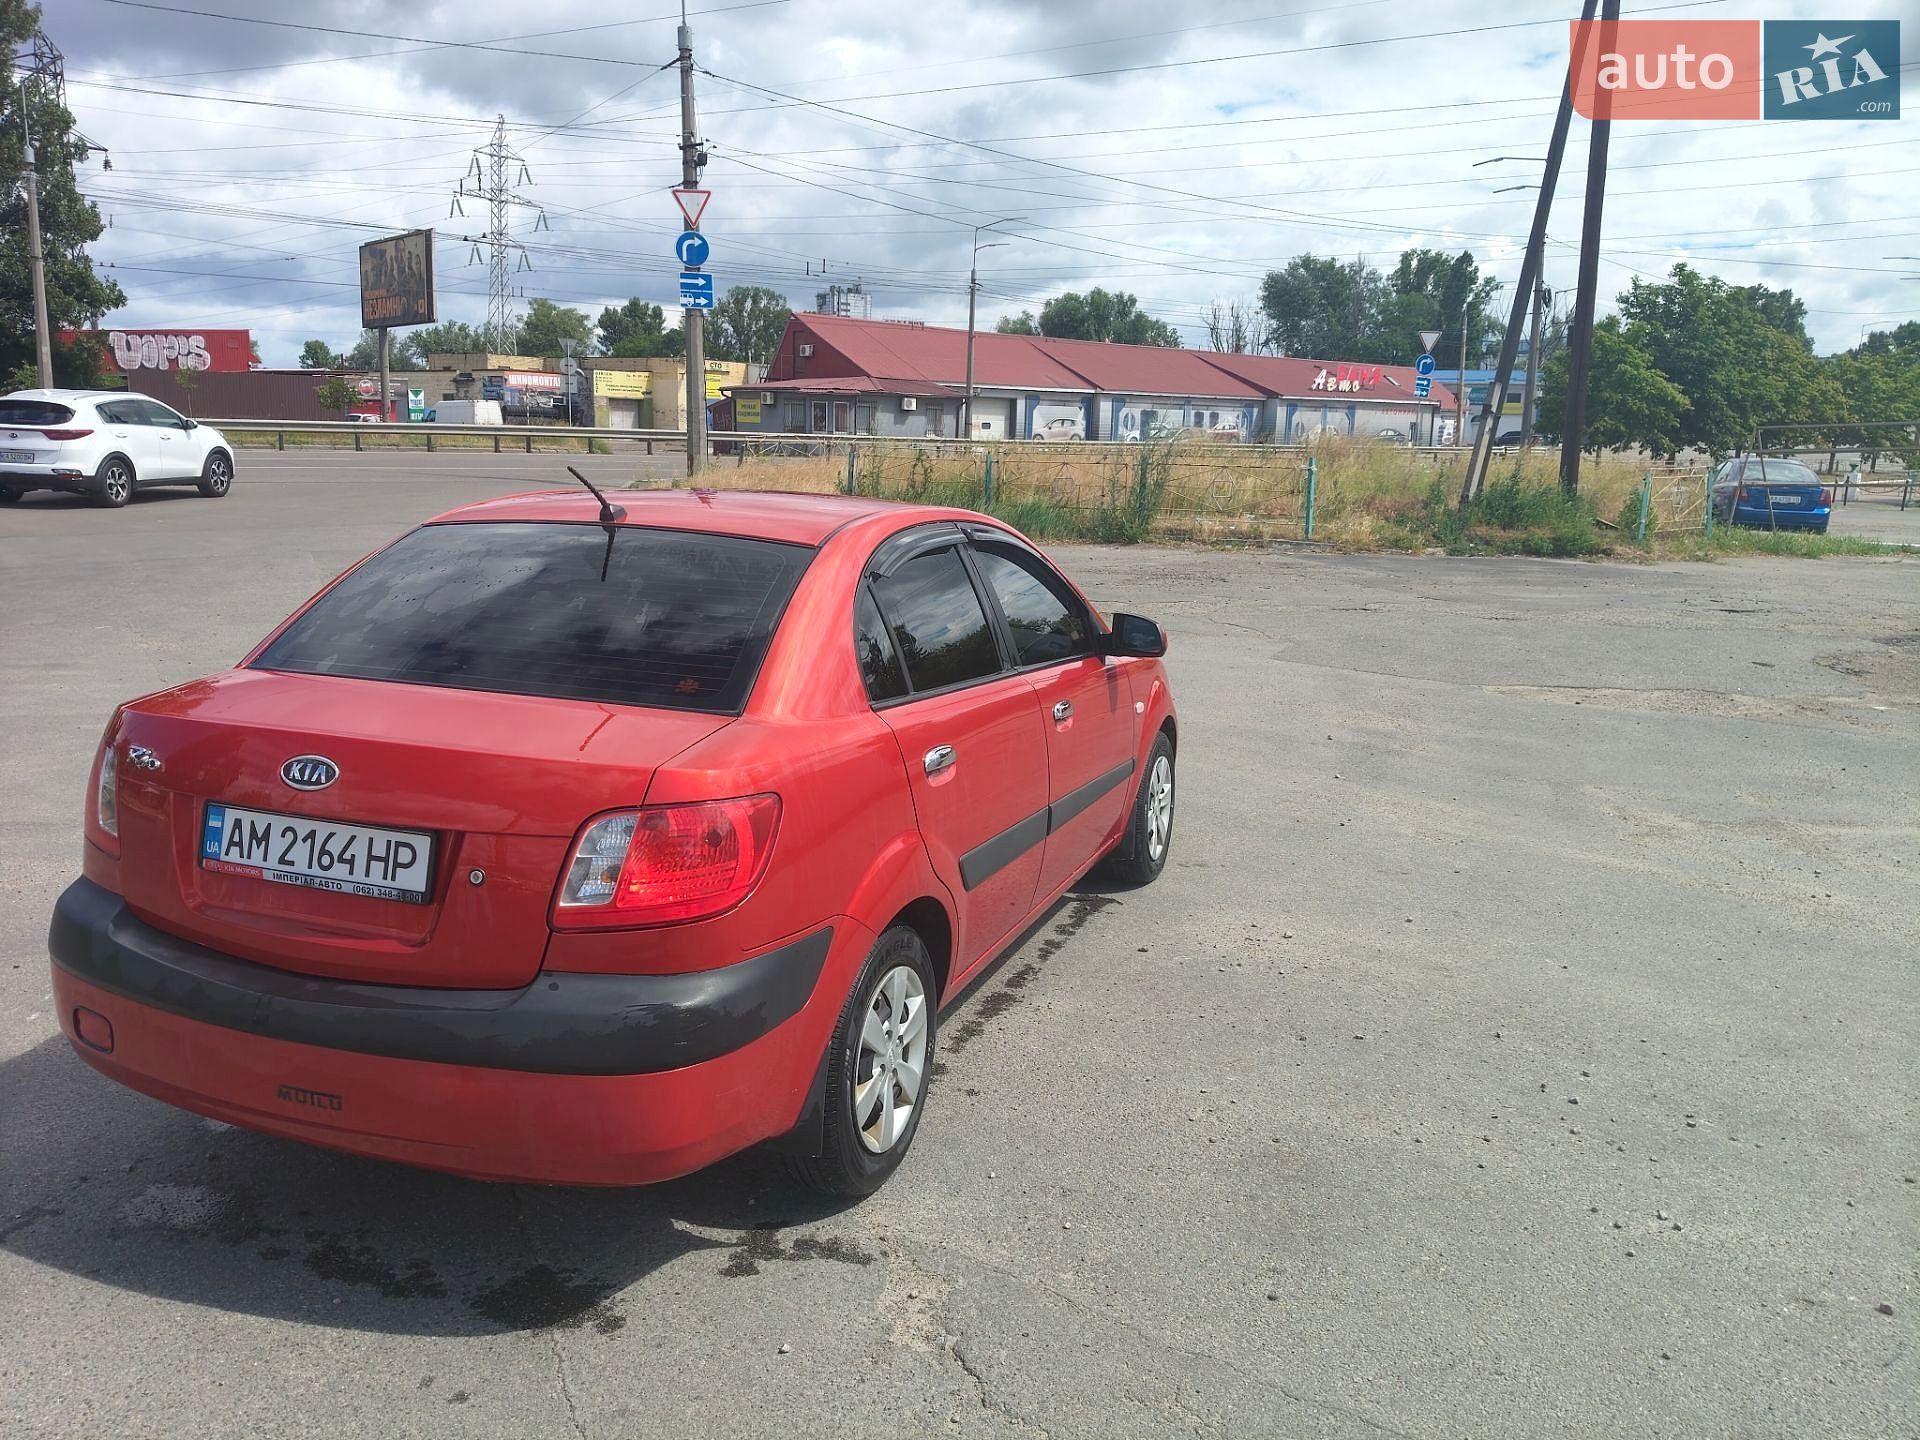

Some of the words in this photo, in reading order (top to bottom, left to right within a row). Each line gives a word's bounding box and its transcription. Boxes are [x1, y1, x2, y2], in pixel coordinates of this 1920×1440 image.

[289, 761, 326, 784] KIA
[206, 839, 220, 854] UA
[352, 884, 375, 897] (062)
